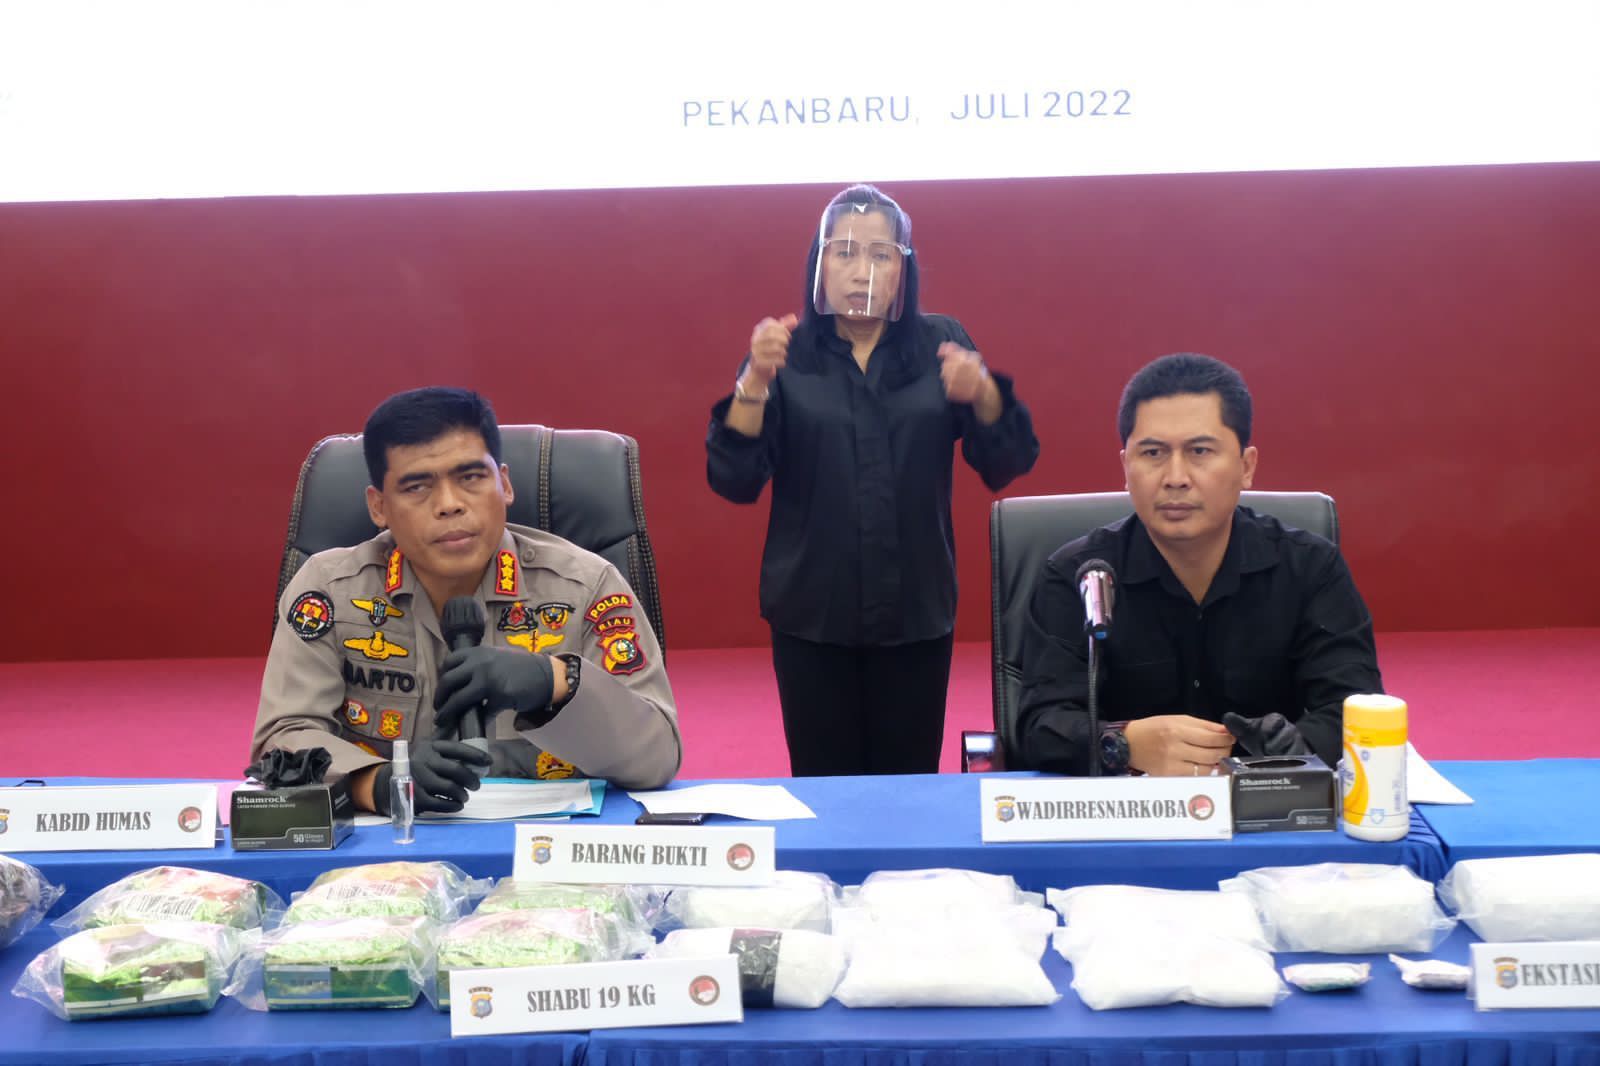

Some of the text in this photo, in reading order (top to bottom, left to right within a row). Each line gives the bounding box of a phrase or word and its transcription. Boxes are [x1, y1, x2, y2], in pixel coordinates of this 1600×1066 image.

[683, 89, 1132, 127] PEKANBARU, JULI 2022
[590, 596, 629, 618] POLDA
[598, 618, 631, 632] RIAU
[1240, 777, 1291, 786] Shamrock
[237, 796, 286, 804] Shamrock
[1017, 799, 1188, 820] WADIRRESNARKOBA
[36, 811, 151, 833] KABID HUMAS
[571, 842, 707, 867] BARANG BUKTI
[527, 983, 656, 1013] SHABU 19 KG
